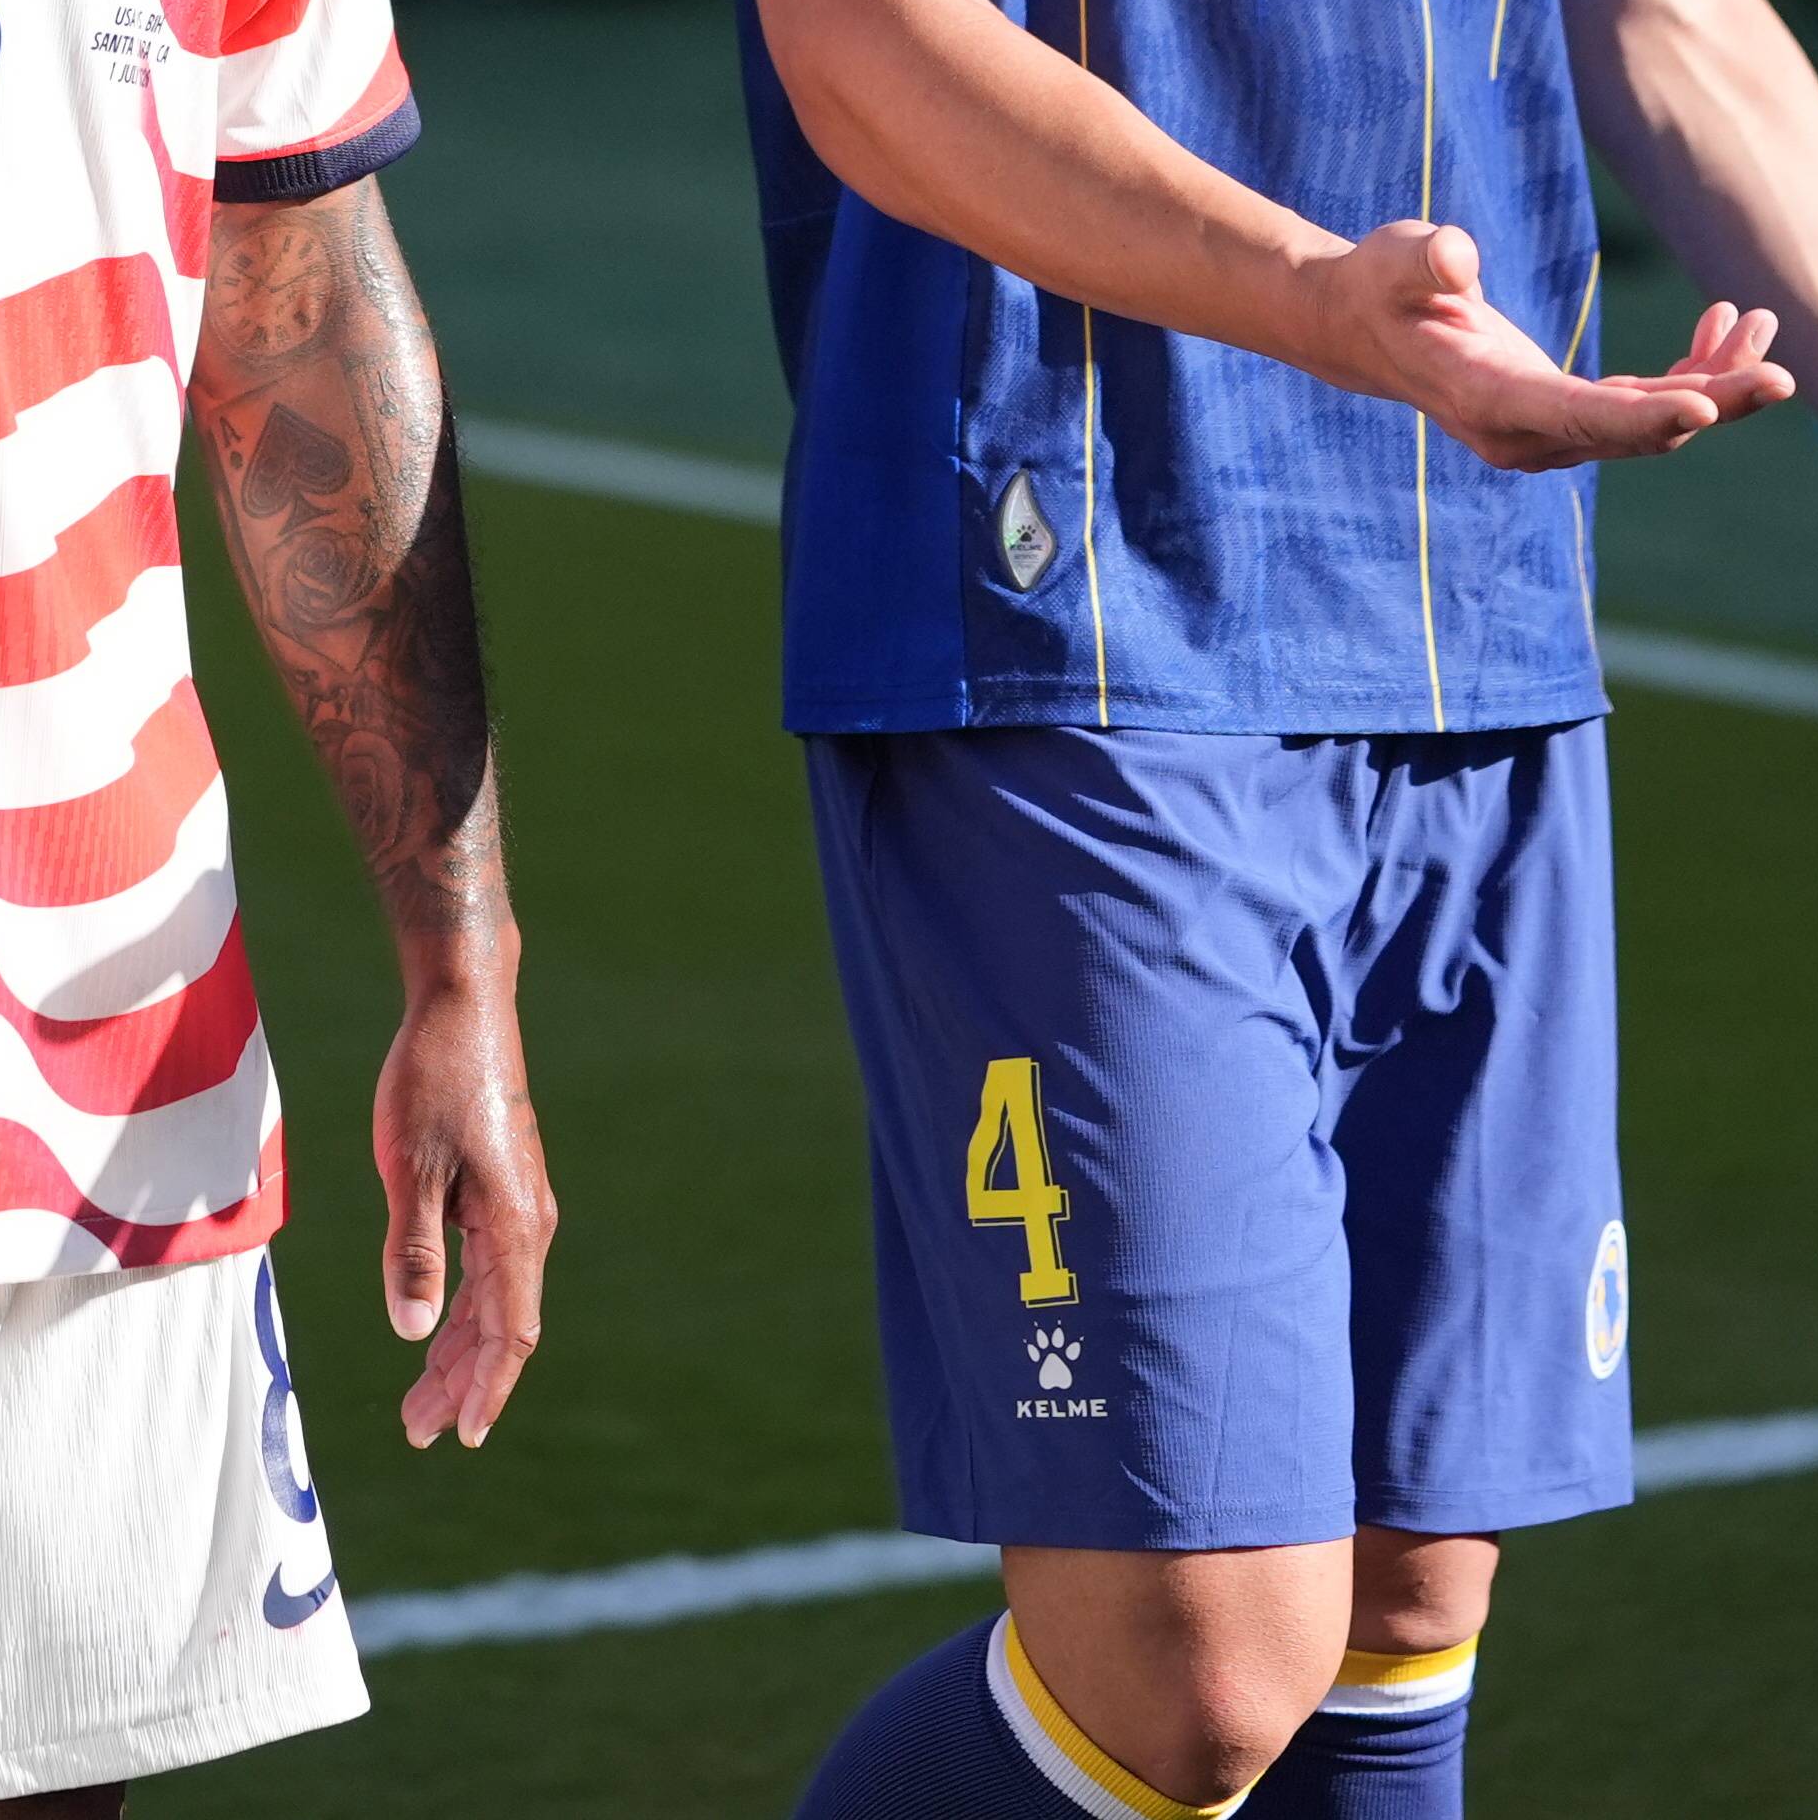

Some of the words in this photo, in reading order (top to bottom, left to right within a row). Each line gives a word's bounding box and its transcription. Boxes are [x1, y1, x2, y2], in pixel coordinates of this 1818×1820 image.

[145, 13, 165, 35] BIH
[91, 31, 135, 56] SANTA
[156, 44, 170, 64] CA
[219, 415, 244, 448] A
[966, 1056, 1080, 1309] 4
[1016, 1398, 1109, 1419] KELME
